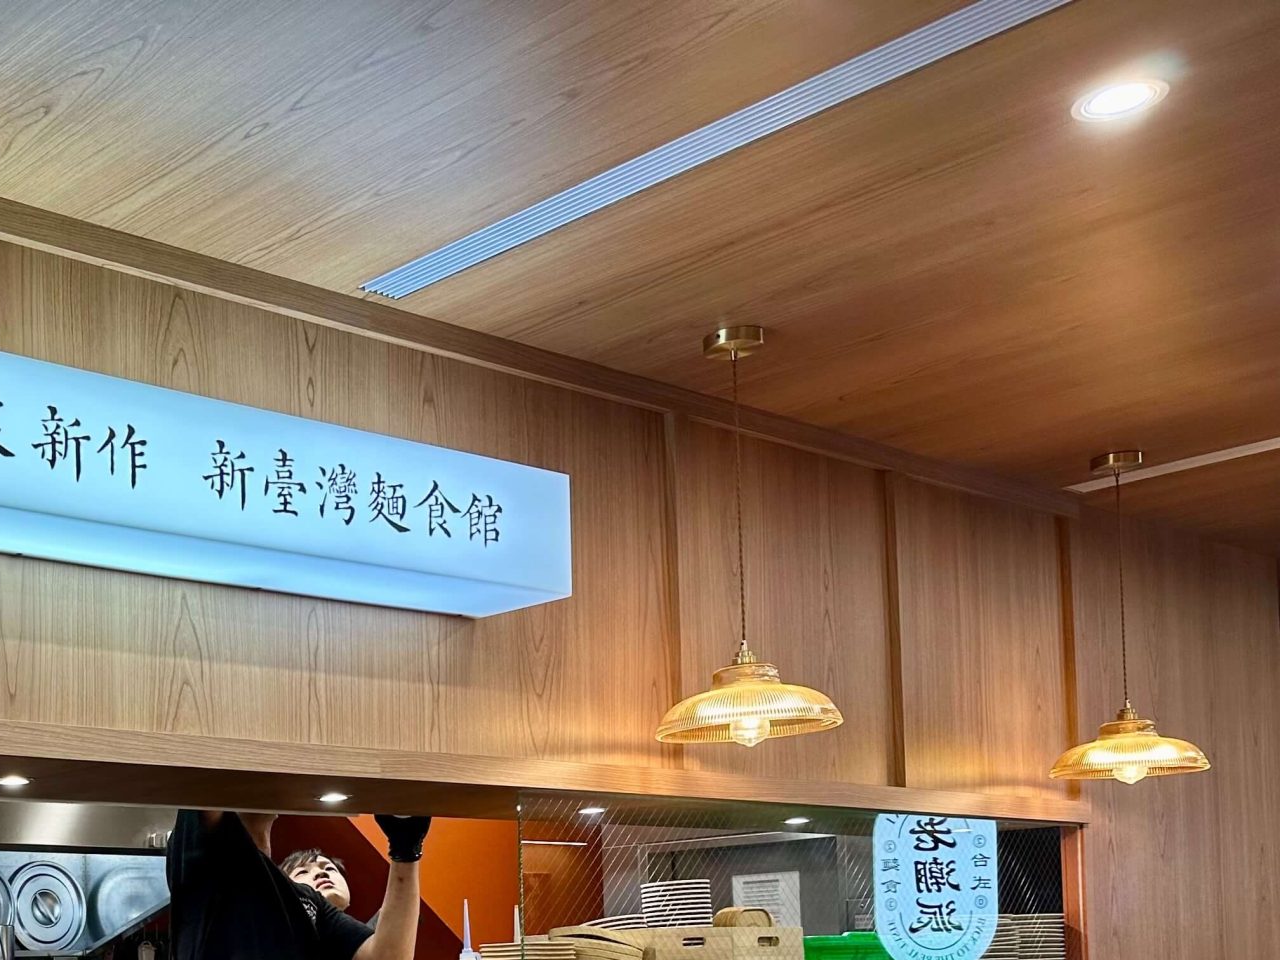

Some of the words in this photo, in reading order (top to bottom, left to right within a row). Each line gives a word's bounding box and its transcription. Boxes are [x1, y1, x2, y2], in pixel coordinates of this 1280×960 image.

[202, 439, 503, 548] 新臺灣麵食館
